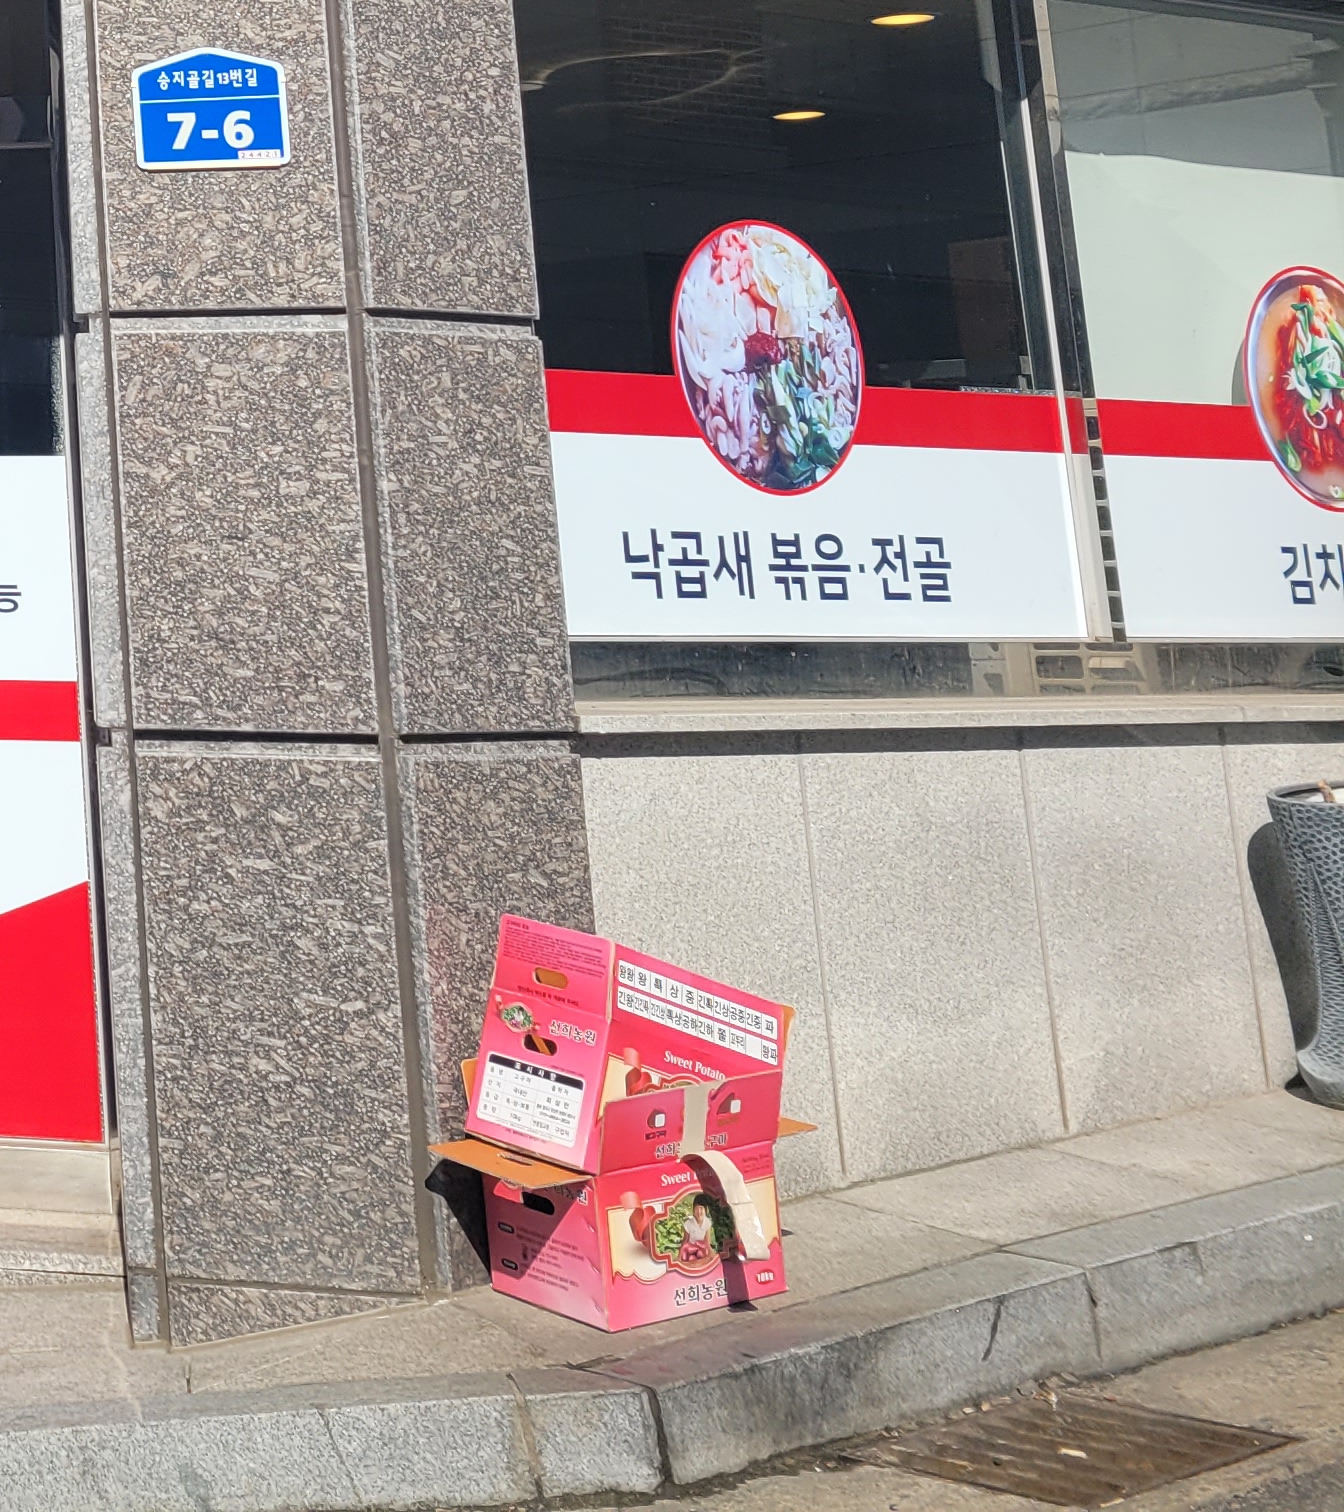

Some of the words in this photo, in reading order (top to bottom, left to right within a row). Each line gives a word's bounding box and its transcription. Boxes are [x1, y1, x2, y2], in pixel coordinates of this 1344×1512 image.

[166, 110, 255, 150] 7-6
[622, 528, 756, 601] 낙곱새
[550, 1020, 596, 1044] 선희농원
[664, 1050, 692, 1070] Sweet
[695, 1063, 725, 1080] Potato
[661, 1172, 691, 1186] Sweet
[674, 1279, 728, 1306] 선희농원
